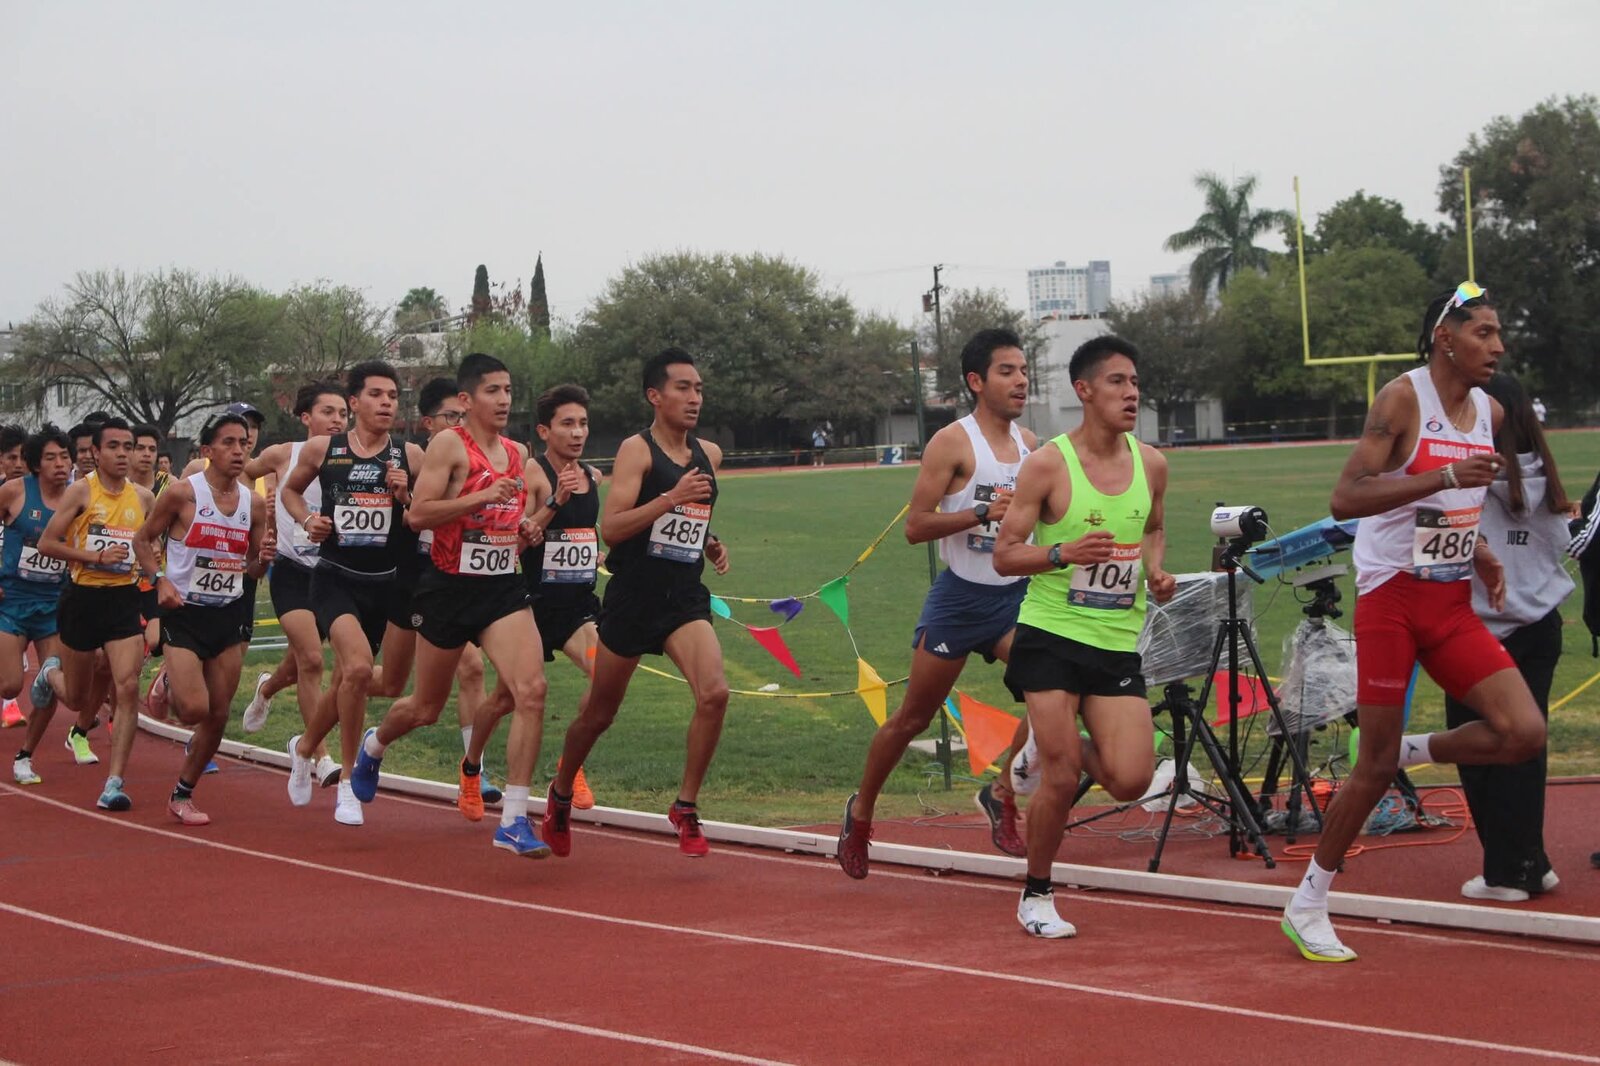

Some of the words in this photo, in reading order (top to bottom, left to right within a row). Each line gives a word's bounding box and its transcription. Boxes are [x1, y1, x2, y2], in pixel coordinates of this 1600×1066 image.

[890, 446, 903, 464] 2
[349, 470, 381, 480] CRUZ
[348, 497, 390, 505] GATORADE
[341, 509, 385, 531] 200
[660, 518, 703, 545] 485
[1506, 530, 1530, 546] JUEZ
[551, 545, 592, 567] 409
[1421, 530, 1475, 561] 486
[26, 552, 61, 572] 405
[469, 548, 510, 571] 508
[196, 573, 235, 593] 464
[1084, 562, 1133, 590] 104
